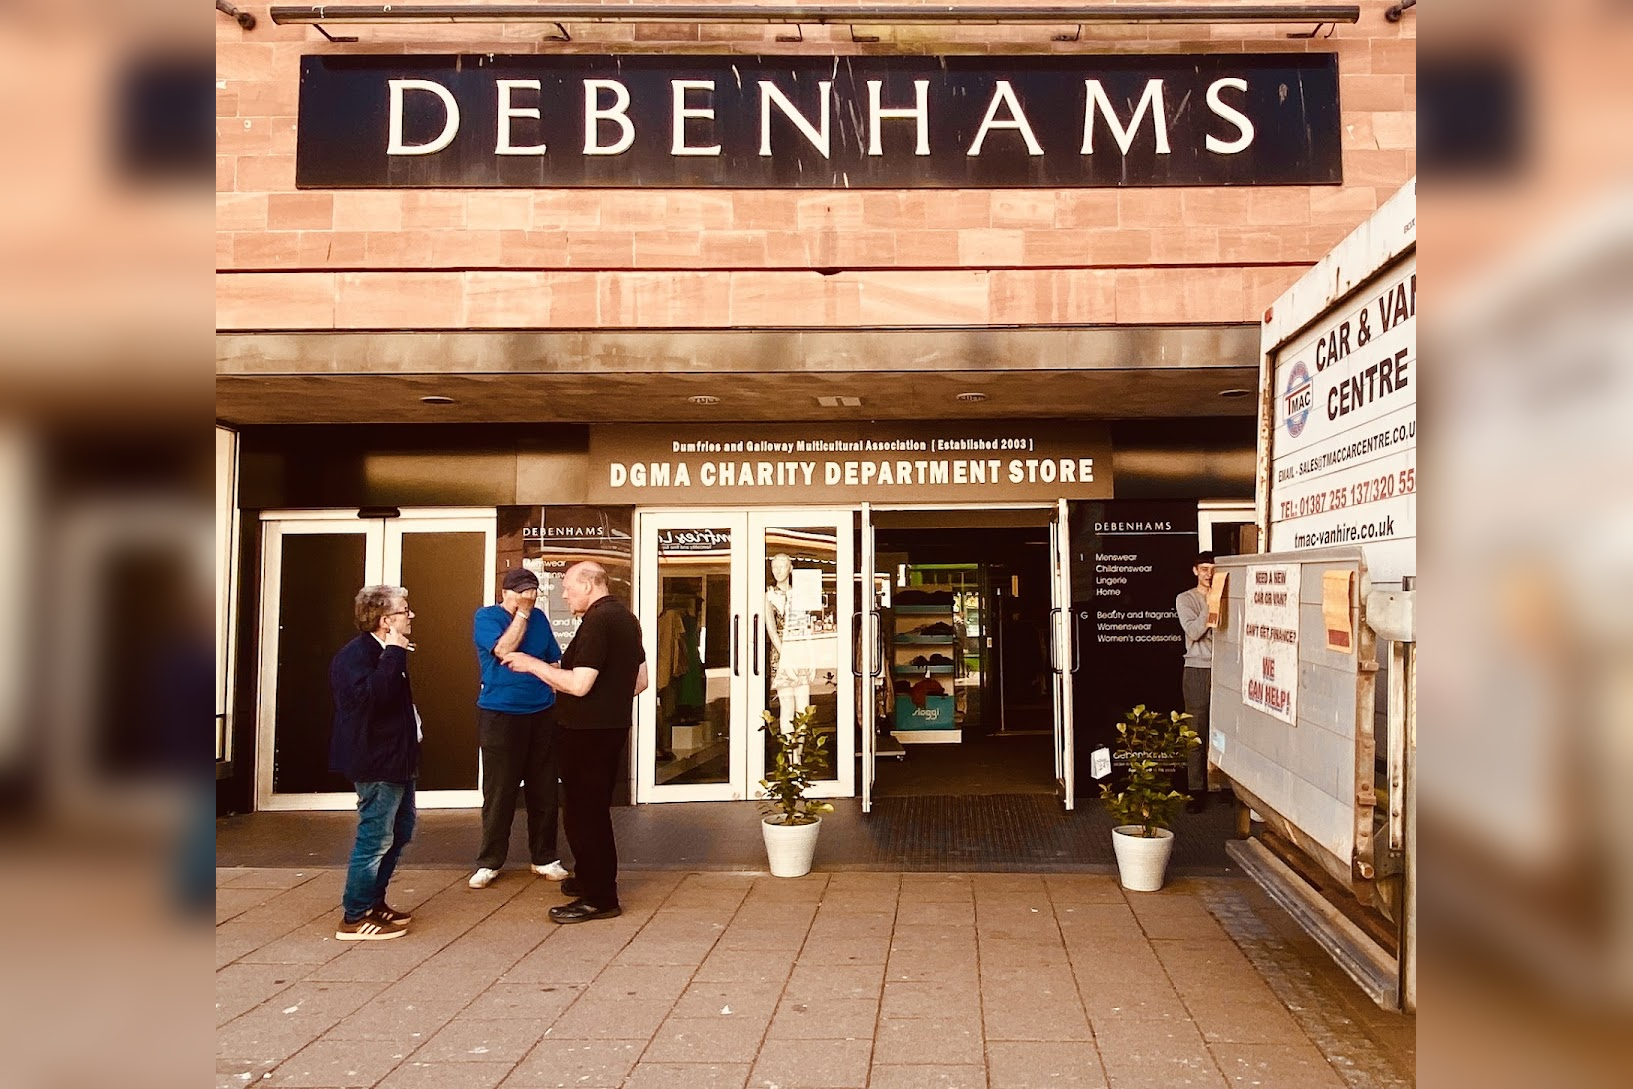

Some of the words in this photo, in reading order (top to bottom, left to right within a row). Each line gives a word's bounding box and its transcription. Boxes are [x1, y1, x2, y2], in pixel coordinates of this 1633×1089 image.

[386, 77, 1256, 157] DEBENHAMS
[1316, 321, 1351, 372] CAR
[1358, 308, 1371, 347] &
[1327, 347, 1408, 421] CENTRE
[672, 440, 721, 453] Dumfries
[724, 440, 743, 452] and
[746, 440, 794, 454] Galloway
[796, 439, 863, 452] Multicultural
[866, 439, 926, 451] Association
[938, 438, 998, 451] Established
[1000, 438, 1027, 450] 2003
[610, 462, 691, 487] DGMA
[700, 461, 816, 487] CHARITY
[824, 459, 1001, 486] DEPARTMENT
[1008, 458, 1094, 484] STORE
[1278, 466, 1295, 483] EMAIL
[1281, 500, 1298, 519] TEL:
[1300, 492, 1327, 516] 01387
[1329, 487, 1347, 510] 255
[1351, 474, 1395, 506] 137/320
[1399, 468, 1416, 494] 55
[522, 526, 604, 537] DEBENHAMS
[1094, 521, 1172, 531] DEBENHAMS
[1294, 514, 1395, 549] tmac-vanhire.co.uk
[1095, 553, 1138, 562] Menswear
[1095, 564, 1153, 573] Childrenswear
[1096, 576, 1127, 586] Lingerie
[1096, 588, 1121, 596] Home
[1080, 611, 1088, 619] G
[1097, 610, 1125, 620] Beauty
[1127, 611, 1144, 619] and
[1097, 622, 1152, 631] Womenswear
[1097, 633, 1134, 642] Women's
[1135, 633, 1182, 642] accessories
[1262, 656, 1275, 679] WE
[1248, 679, 1264, 703] CAN
[1265, 684, 1291, 715] HELP!
